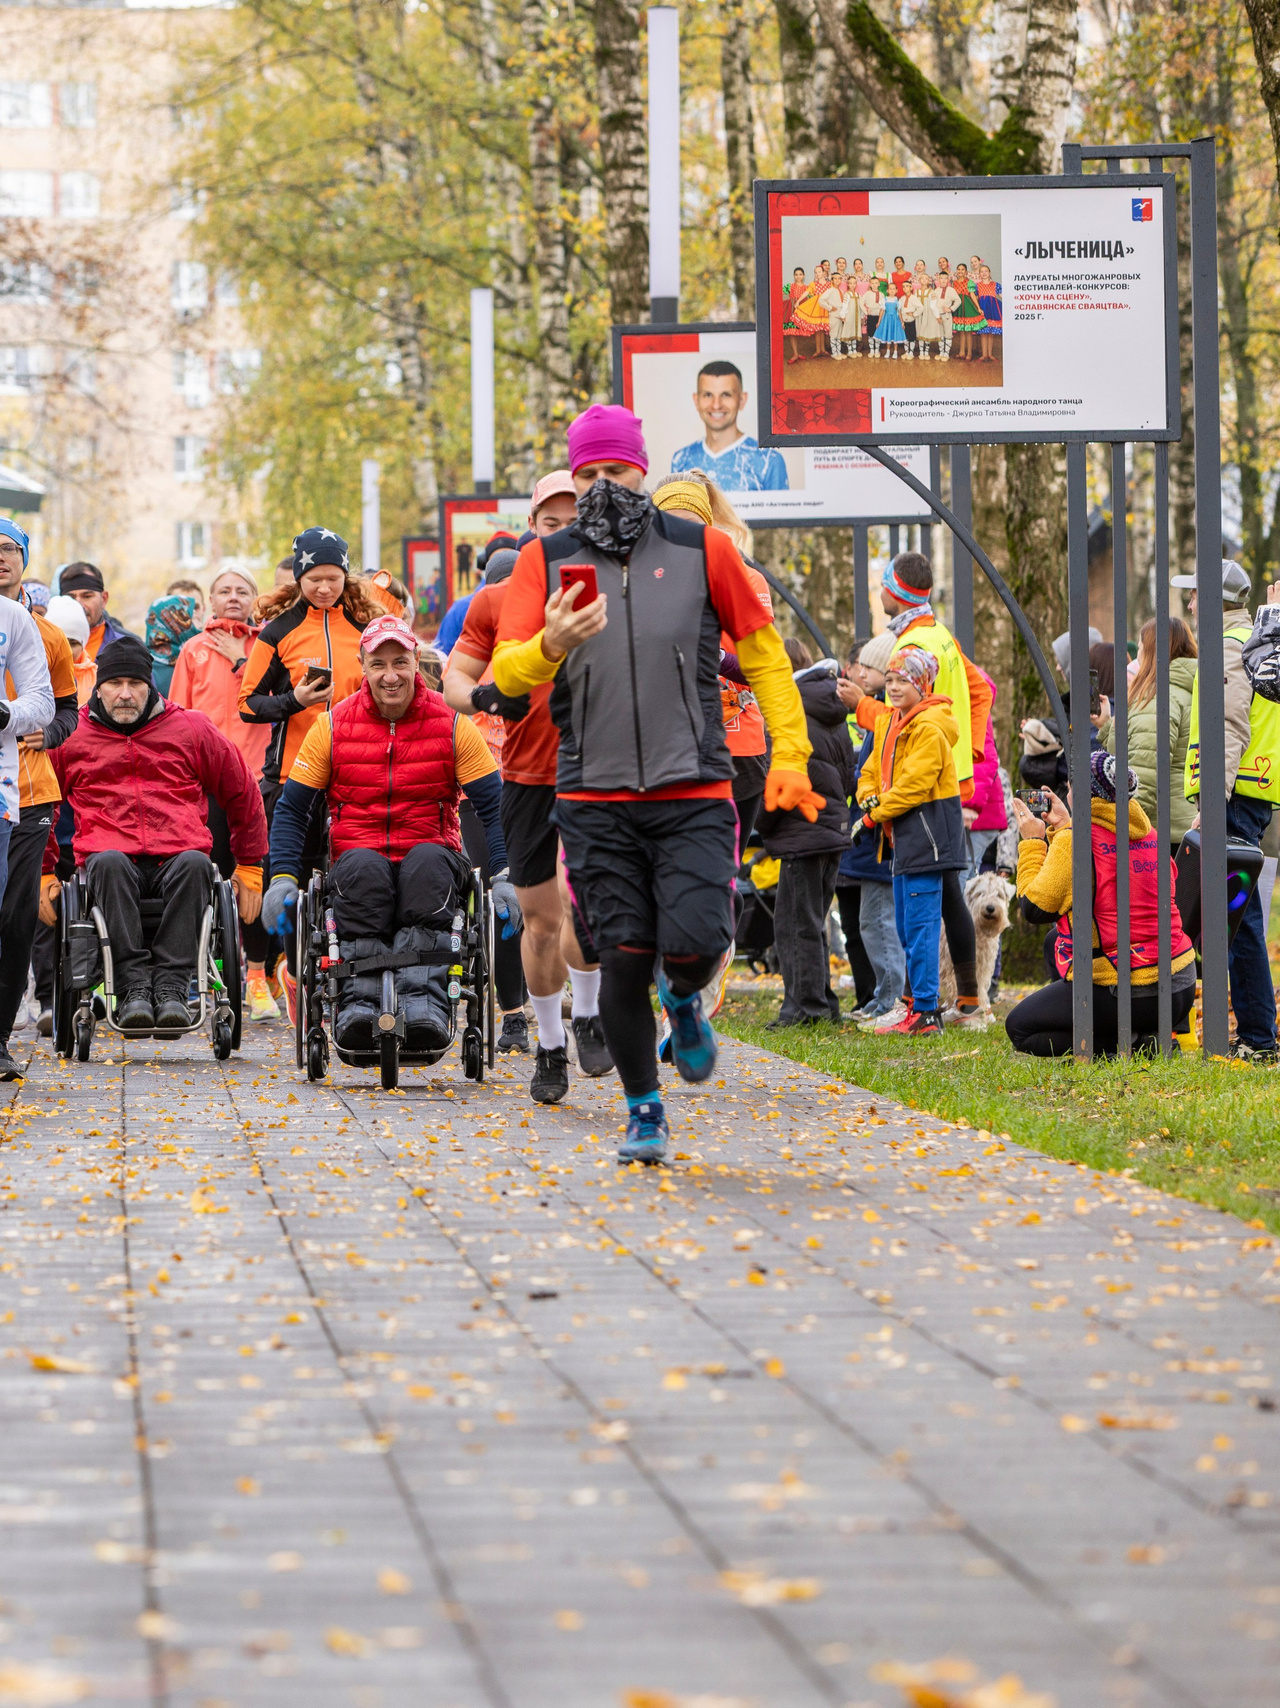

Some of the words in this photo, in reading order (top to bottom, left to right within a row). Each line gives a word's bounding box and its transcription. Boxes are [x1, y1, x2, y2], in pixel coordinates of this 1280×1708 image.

[1014, 240, 1135, 261] «ЛЫЧЕНИЦА»
[1013, 282, 1130, 291] ФЕСТИВАЛЕЙ-КОНКУРСОВ:
[1056, 293, 1092, 302] СЦЕНУ»,
[1014, 303, 1076, 311] «СЛАВЯНСКАЕ
[890, 398, 970, 408] Хореографический
[971, 397, 1012, 406] ансамбль
[1013, 398, 1057, 406] народного
[890, 410, 945, 418] Руководитель
[952, 410, 983, 418] Джурко
[985, 409, 1016, 417] Татьяна
[1017, 408, 1076, 417] Владимировна
